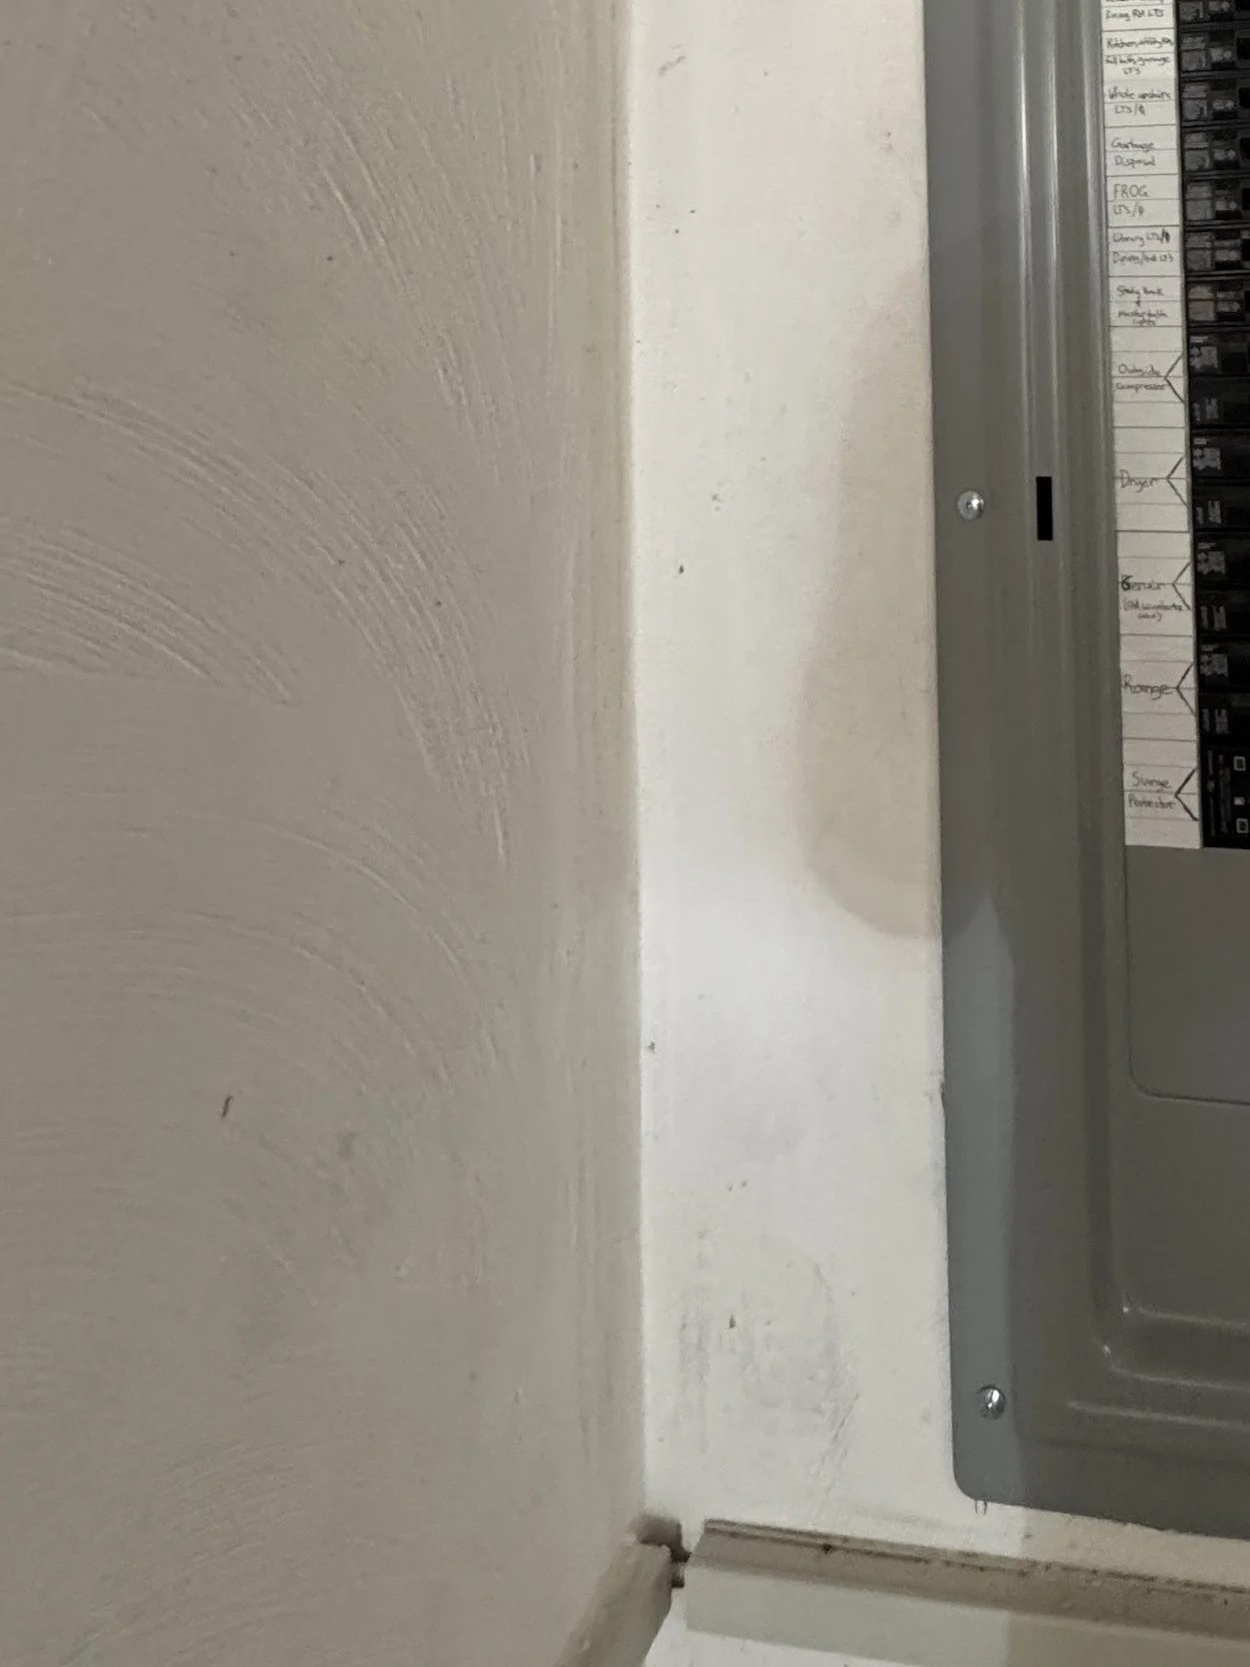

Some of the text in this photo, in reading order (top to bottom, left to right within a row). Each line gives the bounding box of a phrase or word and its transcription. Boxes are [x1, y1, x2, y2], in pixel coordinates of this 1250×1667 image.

[1111, 137, 1155, 152] Garbage
[1114, 154, 1156, 169] Disposal
[1113, 184, 1150, 199] FROG
[1119, 469, 1160, 494] Dryer
[1123, 674, 1174, 700] Range
[1131, 771, 1170, 791] Surge
